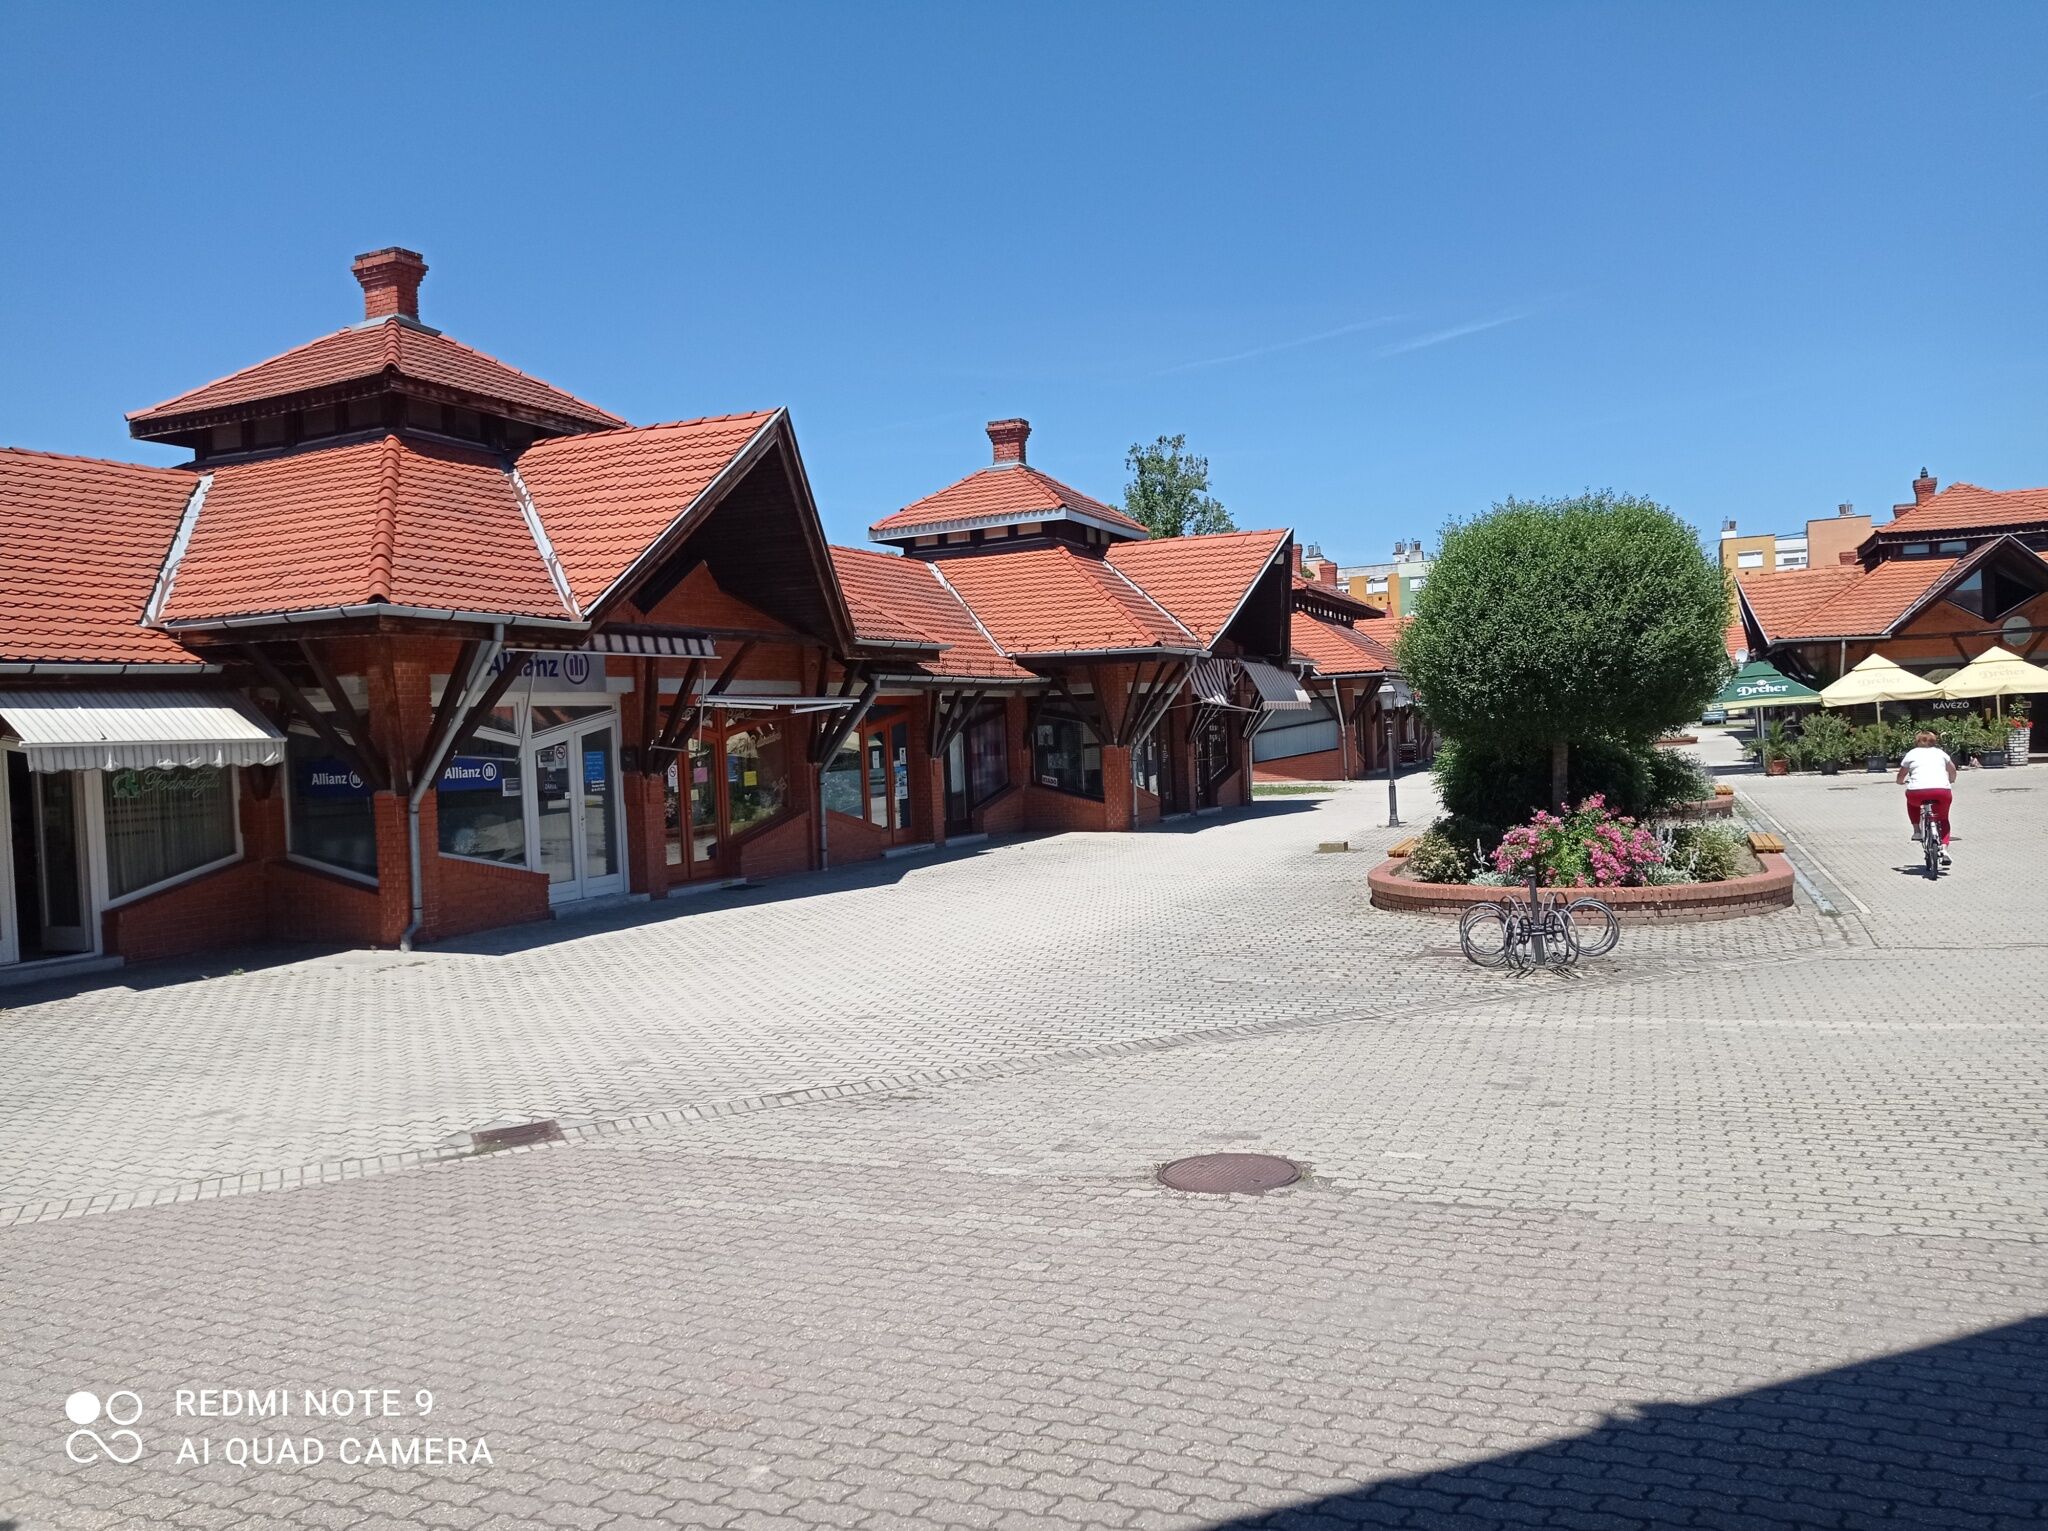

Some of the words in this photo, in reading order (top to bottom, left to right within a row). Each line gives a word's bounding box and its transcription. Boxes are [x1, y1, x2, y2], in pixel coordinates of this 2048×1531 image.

[1736, 684, 1789, 696] Dreher
[311, 772, 348, 786] Allianz
[444, 767, 481, 779] Allianz
